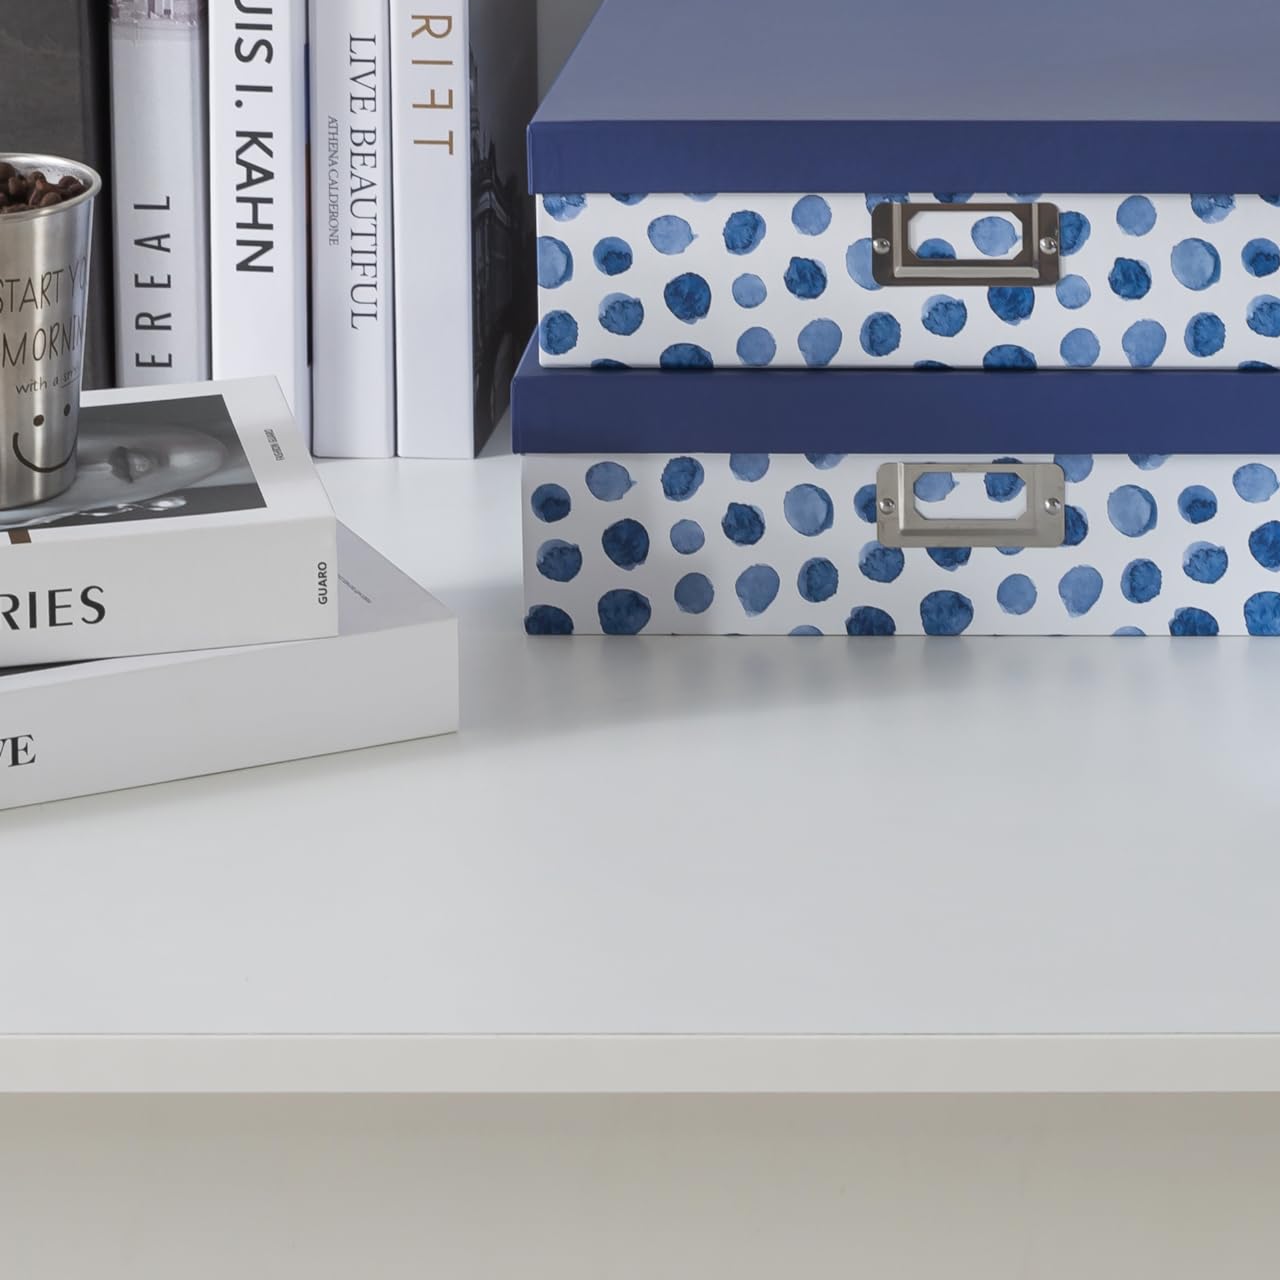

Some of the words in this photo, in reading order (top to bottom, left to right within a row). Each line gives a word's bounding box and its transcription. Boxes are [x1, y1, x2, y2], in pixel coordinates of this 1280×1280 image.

[235, 84, 274, 109] I.
[349, 33, 377, 114] LIVE
[328, 116, 338, 167] ATHENA
[235, 130, 274, 273] KAHN
[328, 168, 339, 246] CALDERONE
[350, 126, 378, 330] BEAUTIFUL
[16, 378, 47, 394] with
[318, 561, 328, 605] GUARO
